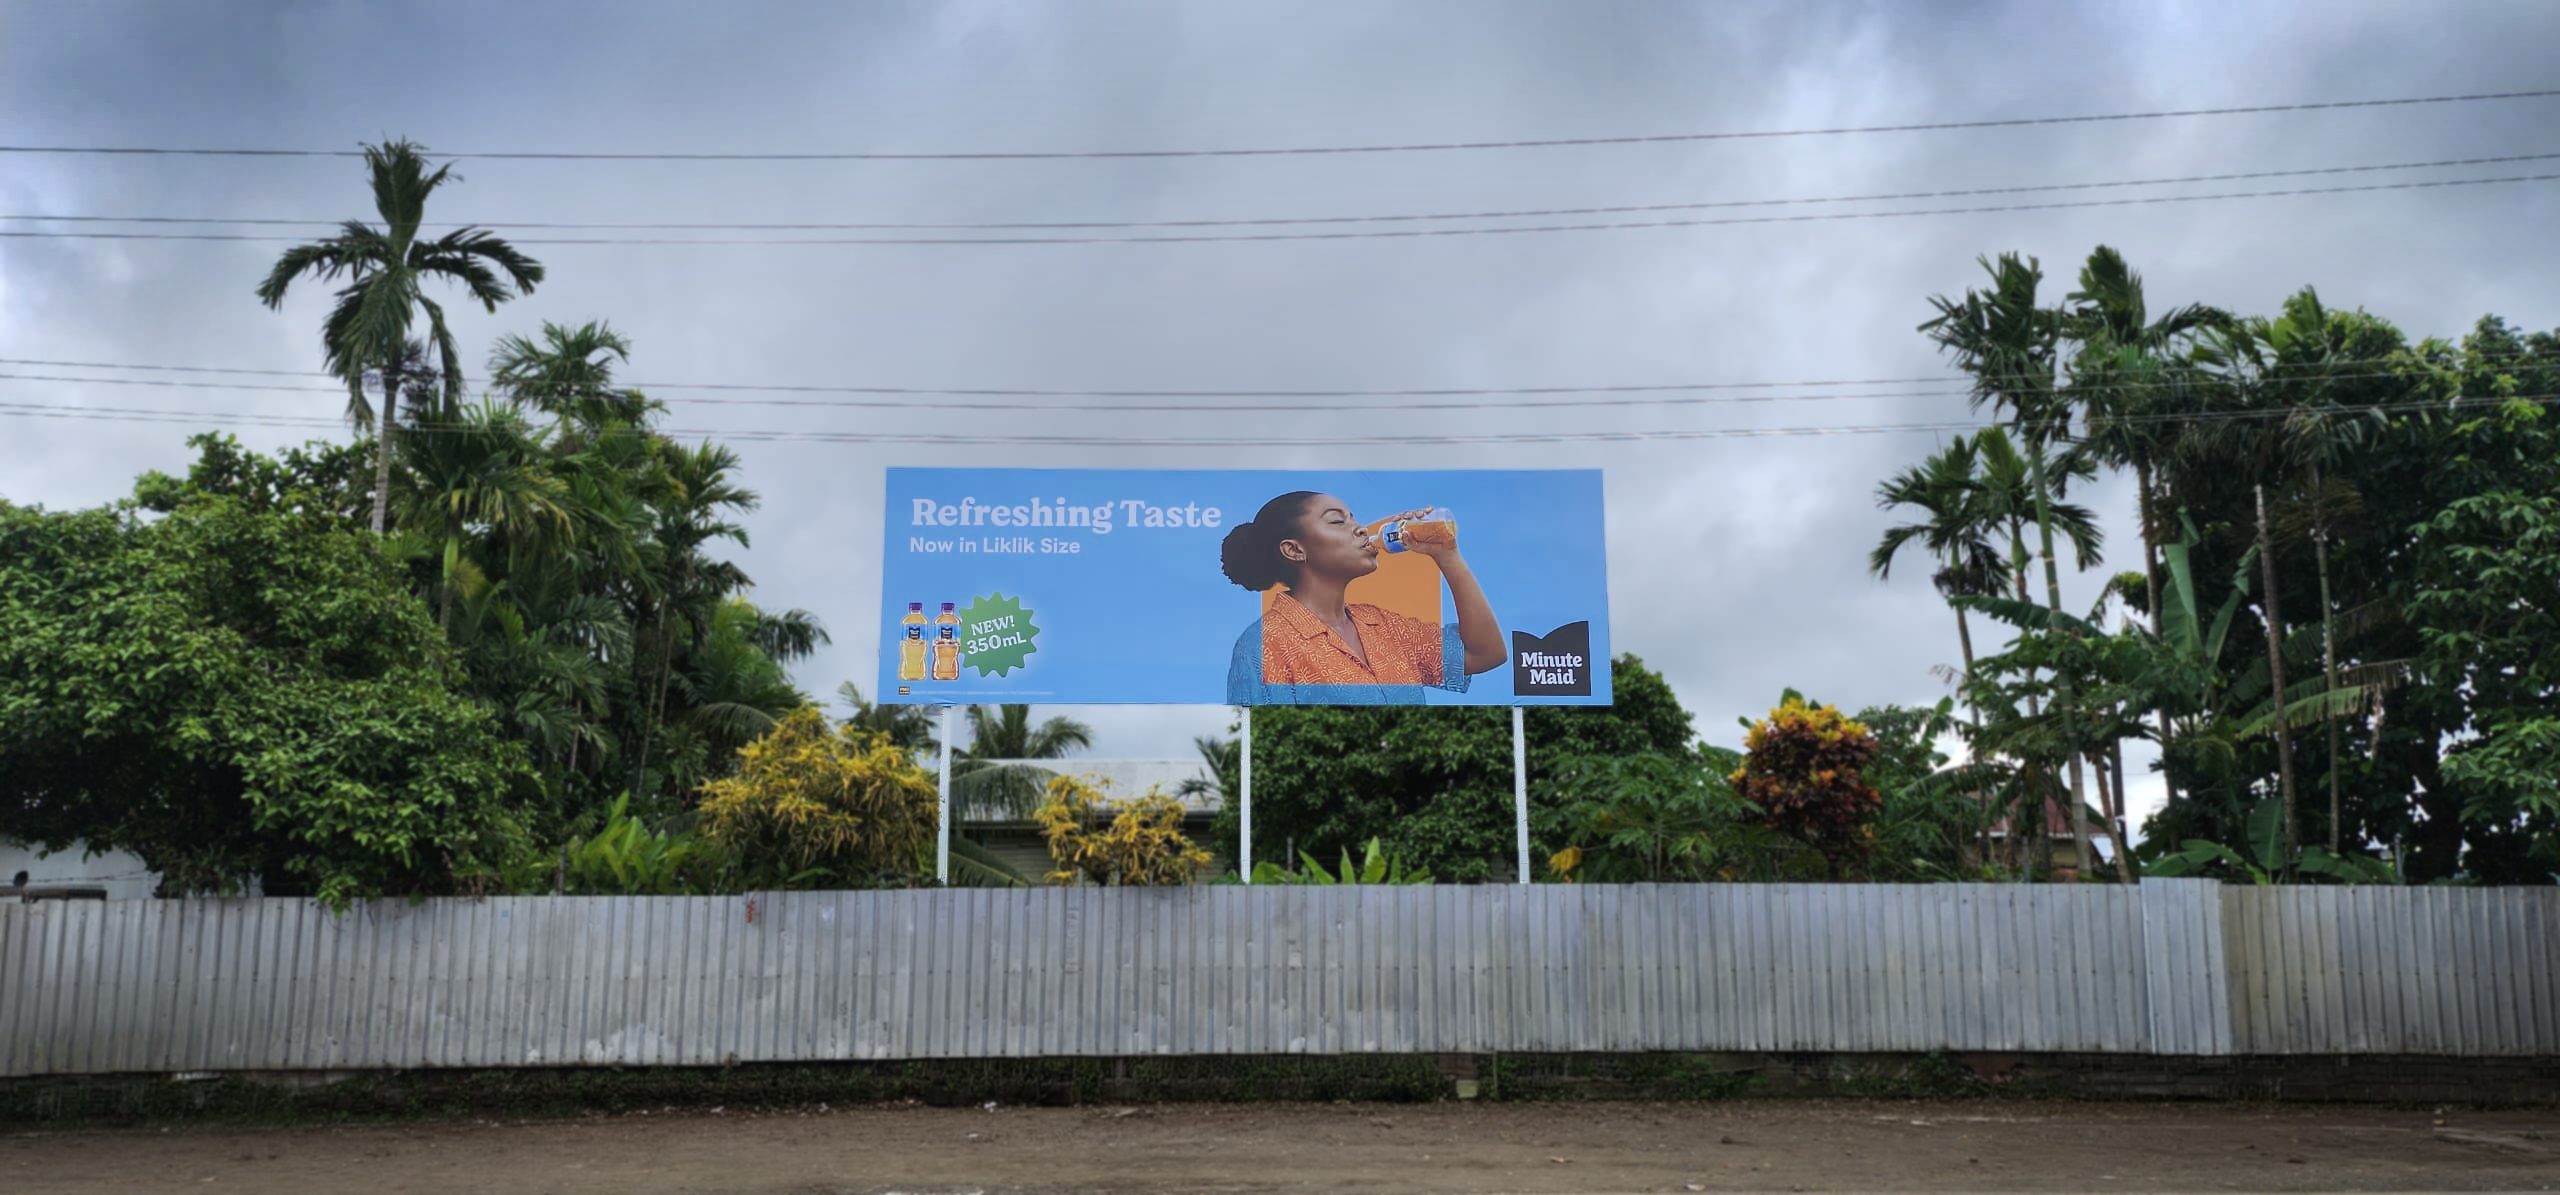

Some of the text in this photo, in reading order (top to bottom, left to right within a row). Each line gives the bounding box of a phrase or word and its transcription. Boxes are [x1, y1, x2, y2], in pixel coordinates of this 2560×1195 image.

[911, 496, 1222, 534] Refreshing Taste
[910, 536, 1081, 554] Now in Liklik Size
[970, 615, 1015, 636] NEW!
[966, 631, 1027, 655] 350mL
[1521, 651, 1583, 668] Minute
[1529, 668, 1575, 685] Maid
